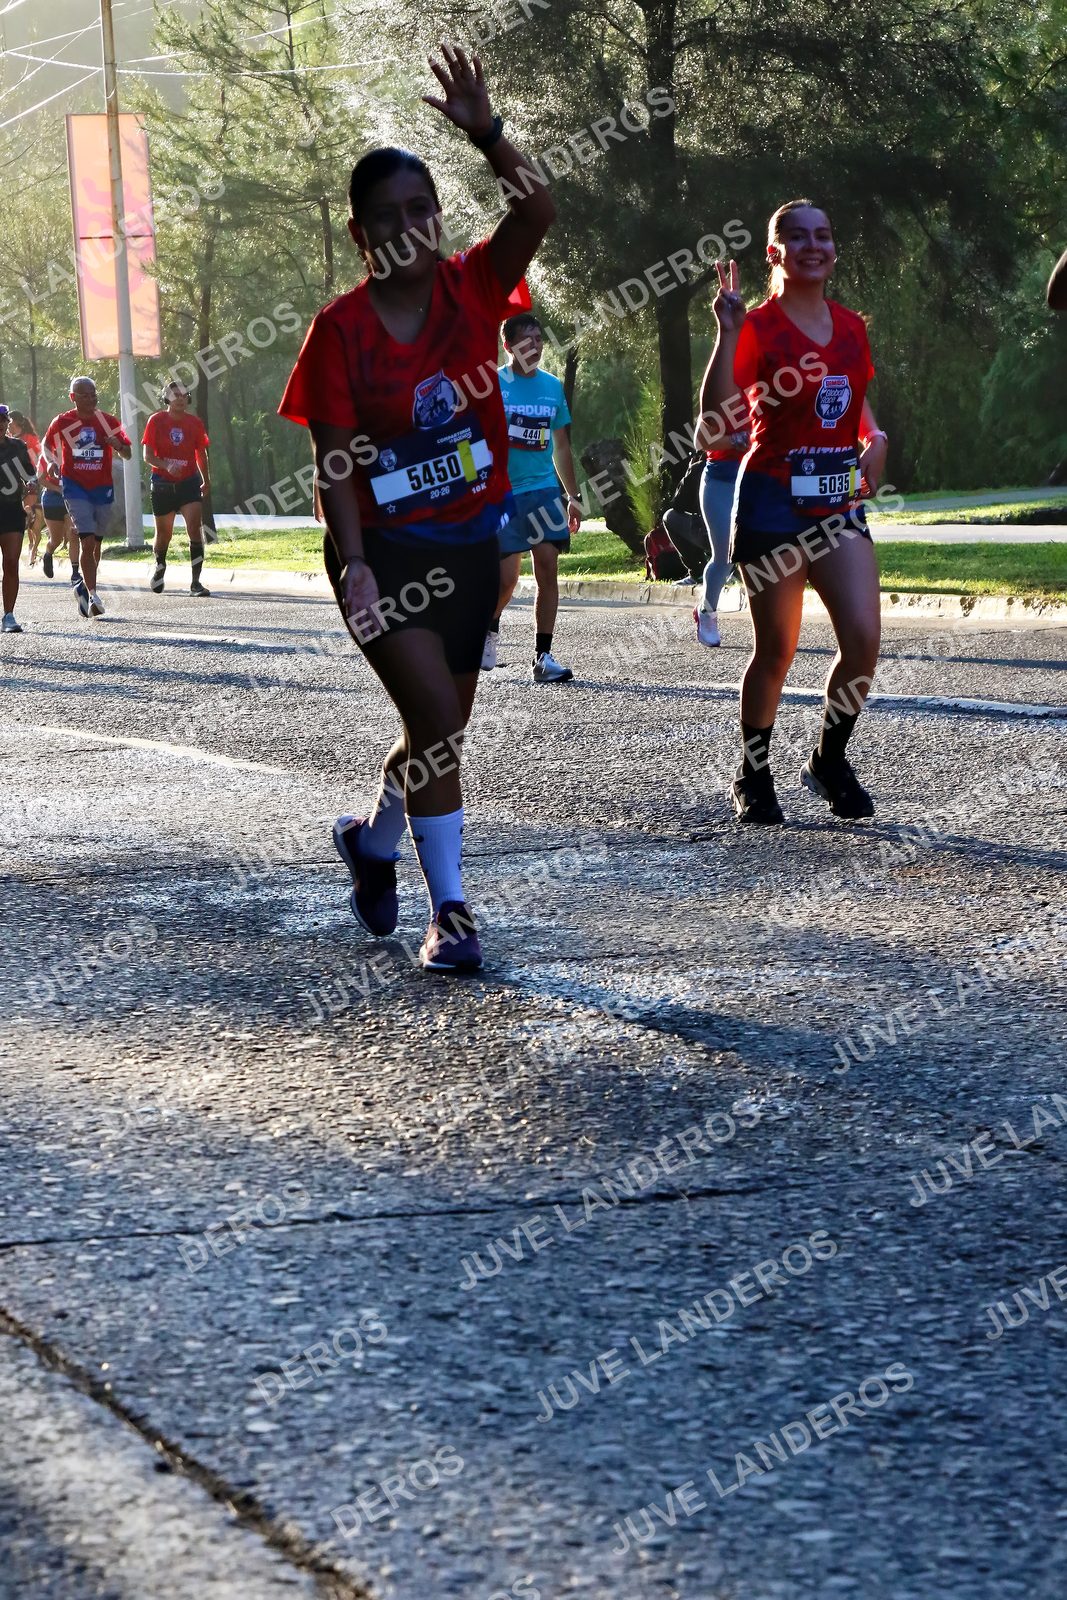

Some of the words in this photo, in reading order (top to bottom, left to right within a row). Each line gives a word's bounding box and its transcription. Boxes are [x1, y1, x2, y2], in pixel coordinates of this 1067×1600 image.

[73, 463, 104, 471] SANTIAGO
[406, 453, 462, 492] 5450
[472, 482, 488, 494] 10K
[819, 473, 850, 495] 5035
[429, 485, 451, 500] 20-26
